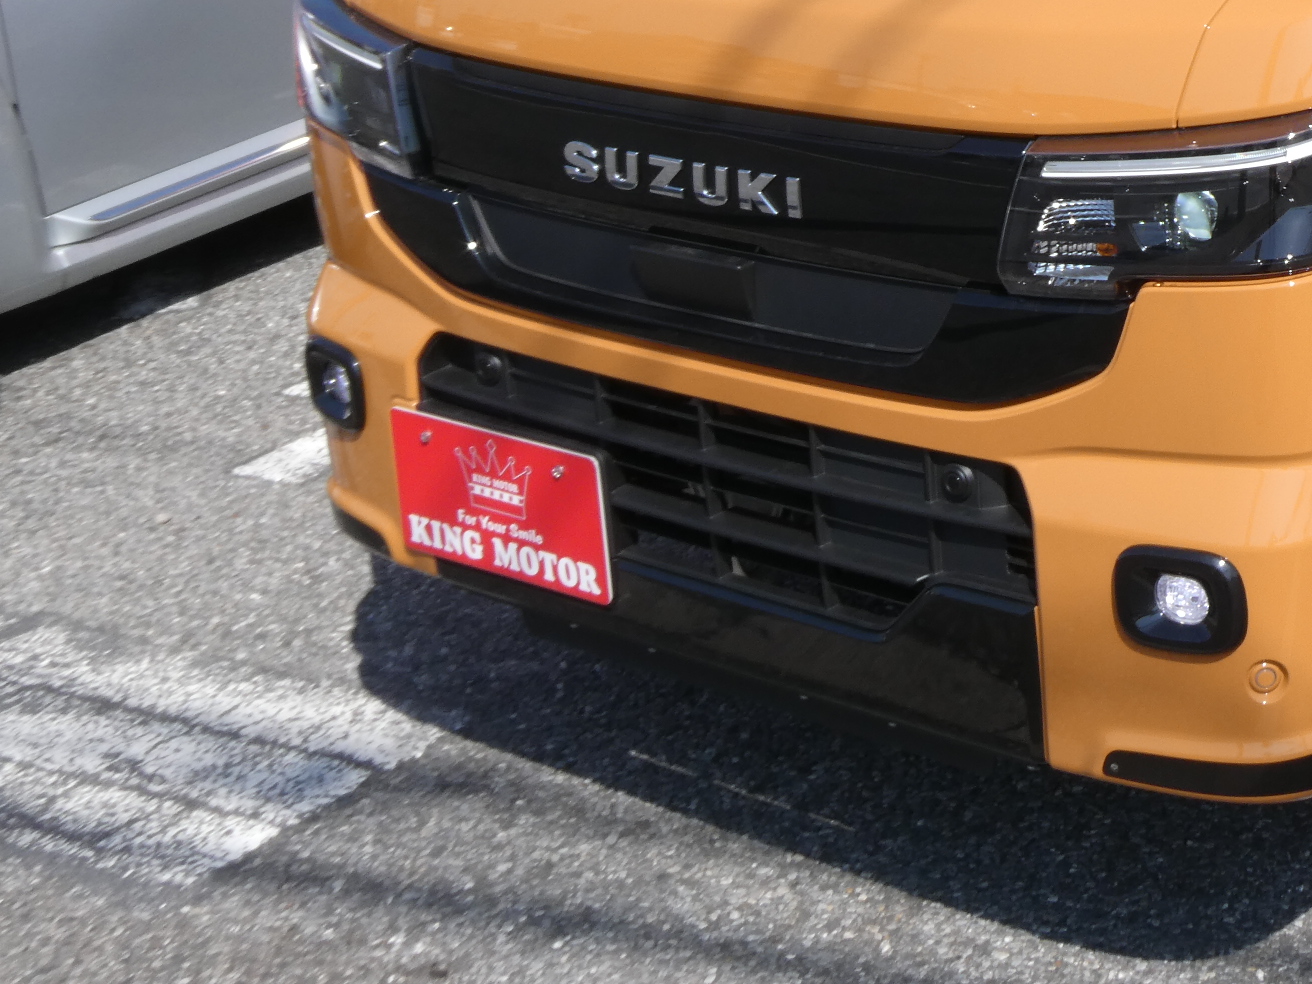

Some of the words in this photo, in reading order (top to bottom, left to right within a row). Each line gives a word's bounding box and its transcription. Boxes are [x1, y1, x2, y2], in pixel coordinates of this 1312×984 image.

[563, 140, 803, 220] SUZUKI
[408, 513, 484, 561] KING
[491, 537, 601, 596] MOTOR
[457, 508, 476, 526] For
[479, 515, 507, 534] Your
[509, 523, 543, 545] Smile
